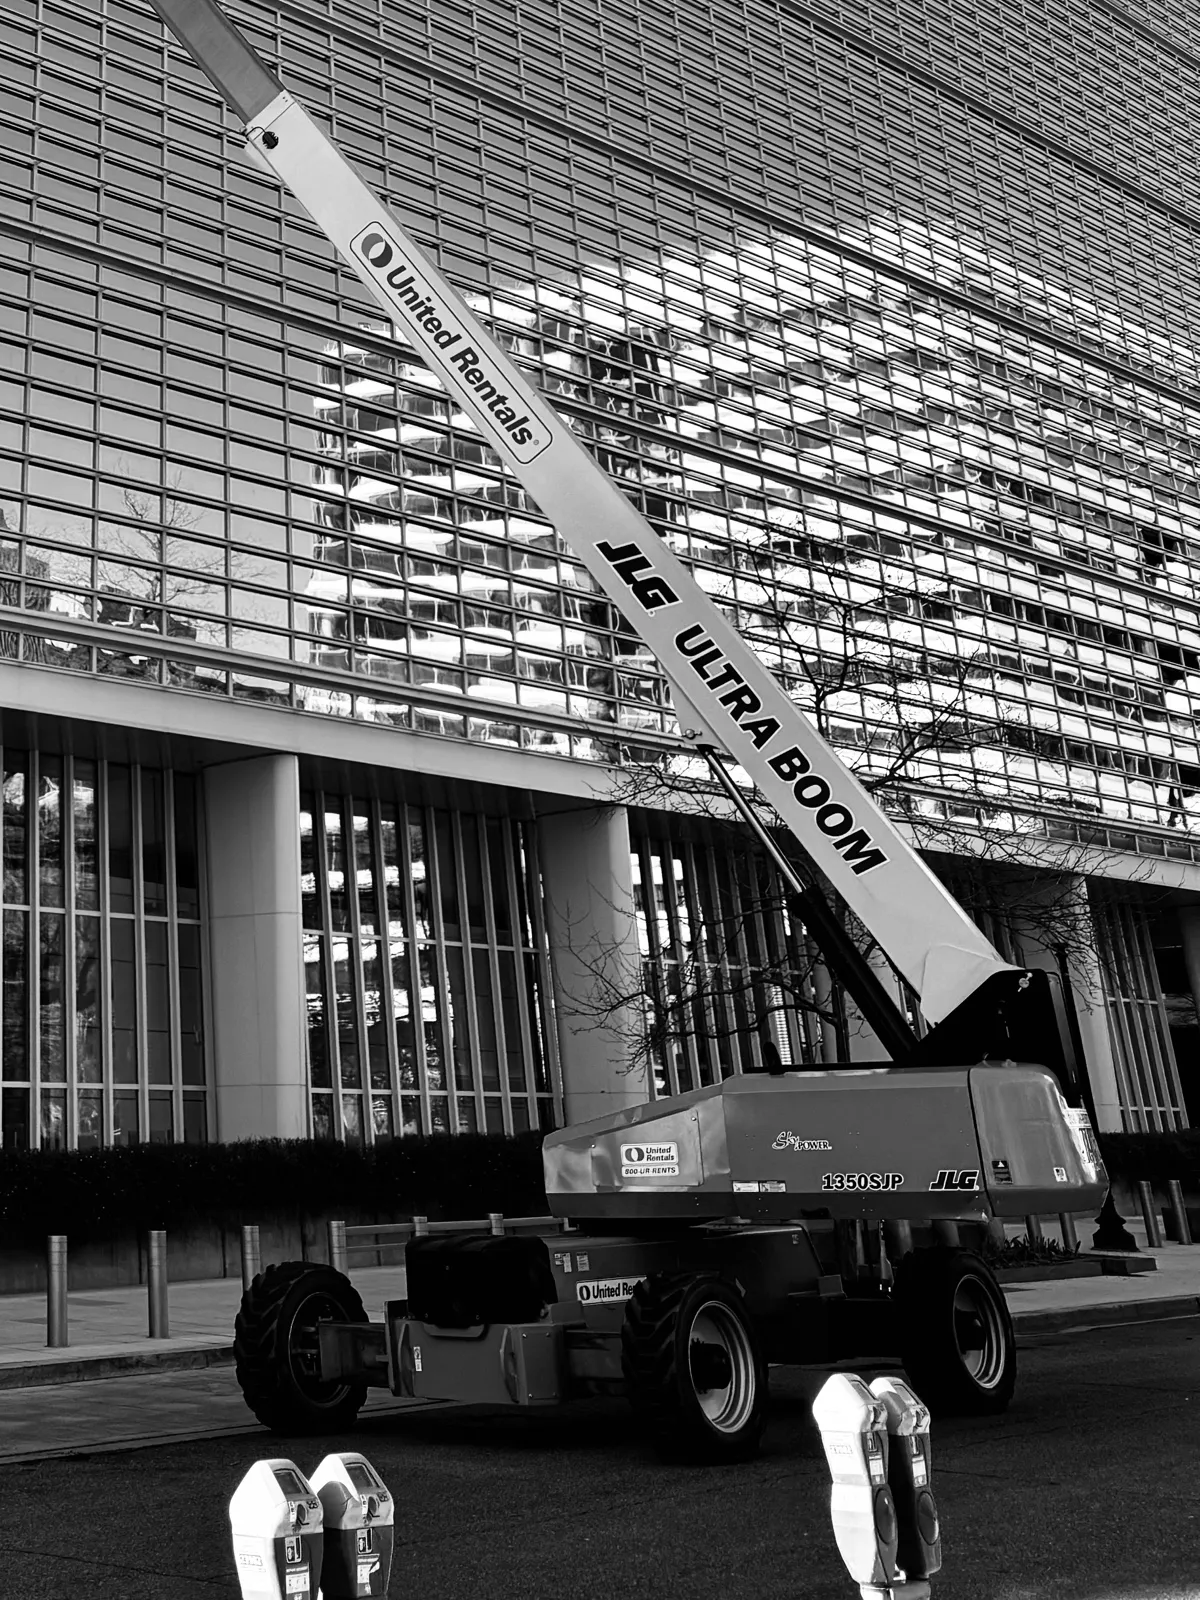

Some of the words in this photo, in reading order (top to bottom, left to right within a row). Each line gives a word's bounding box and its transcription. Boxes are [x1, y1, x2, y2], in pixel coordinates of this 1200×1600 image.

[386, 265, 462, 350] United
[450, 347, 533, 445] Rentals
[593, 539, 683, 613] JLG
[673, 622, 784, 752] ULTRA
[764, 744, 890, 876] BOOM
[645, 1146, 672, 1154] United
[646, 1154, 675, 1162] Rentals
[821, 1172, 905, 1191] 1350SJP
[928, 1169, 980, 1191] JLG
[592, 1282, 621, 1299] United
[622, 1281, 636, 1297] Re
